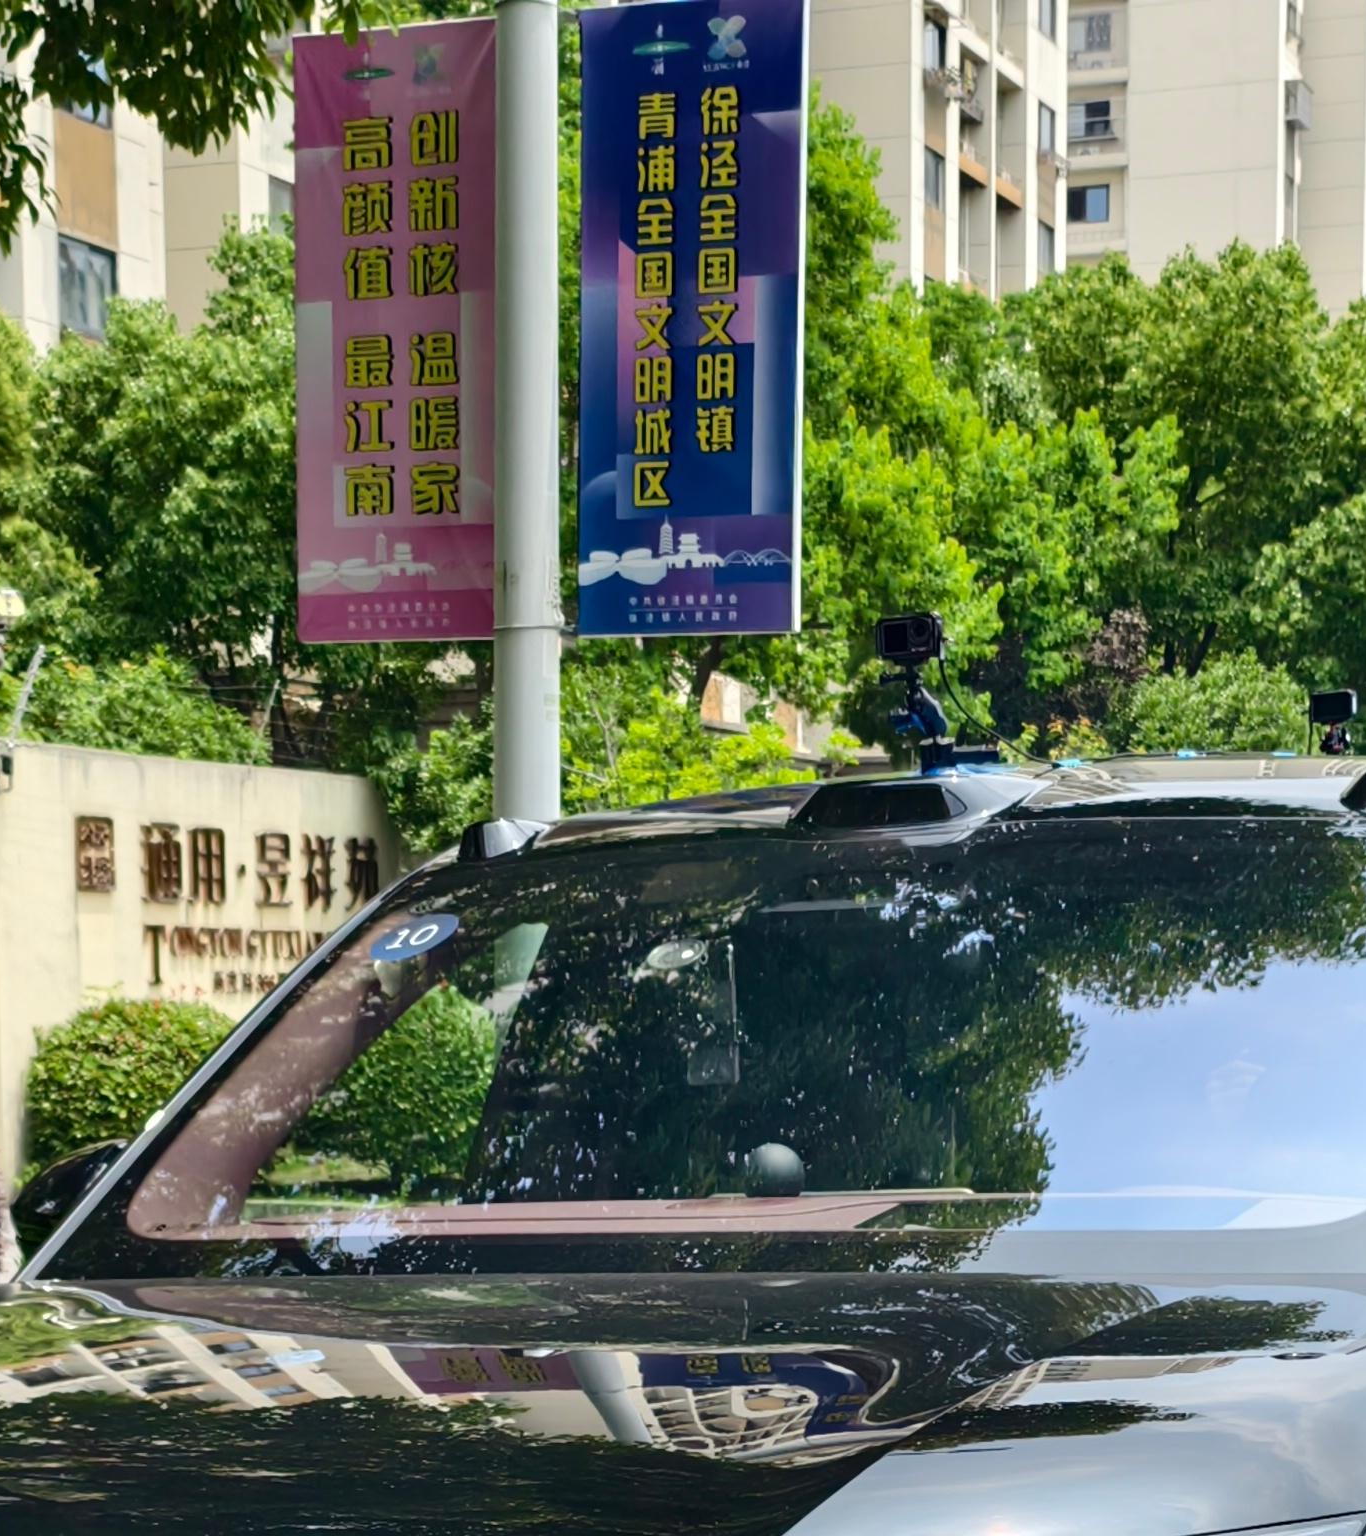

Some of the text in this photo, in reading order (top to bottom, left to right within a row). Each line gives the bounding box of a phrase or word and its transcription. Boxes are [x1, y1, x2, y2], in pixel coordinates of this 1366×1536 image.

[343, 116, 395, 516] 高颜值 最江南
[409, 110, 459, 515] 创新核 温暖家
[634, 92, 676, 507] 青浦全国文明城区
[695, 85, 739, 453] 徐泾全国文明镇
[385, 923, 439, 950] 10
